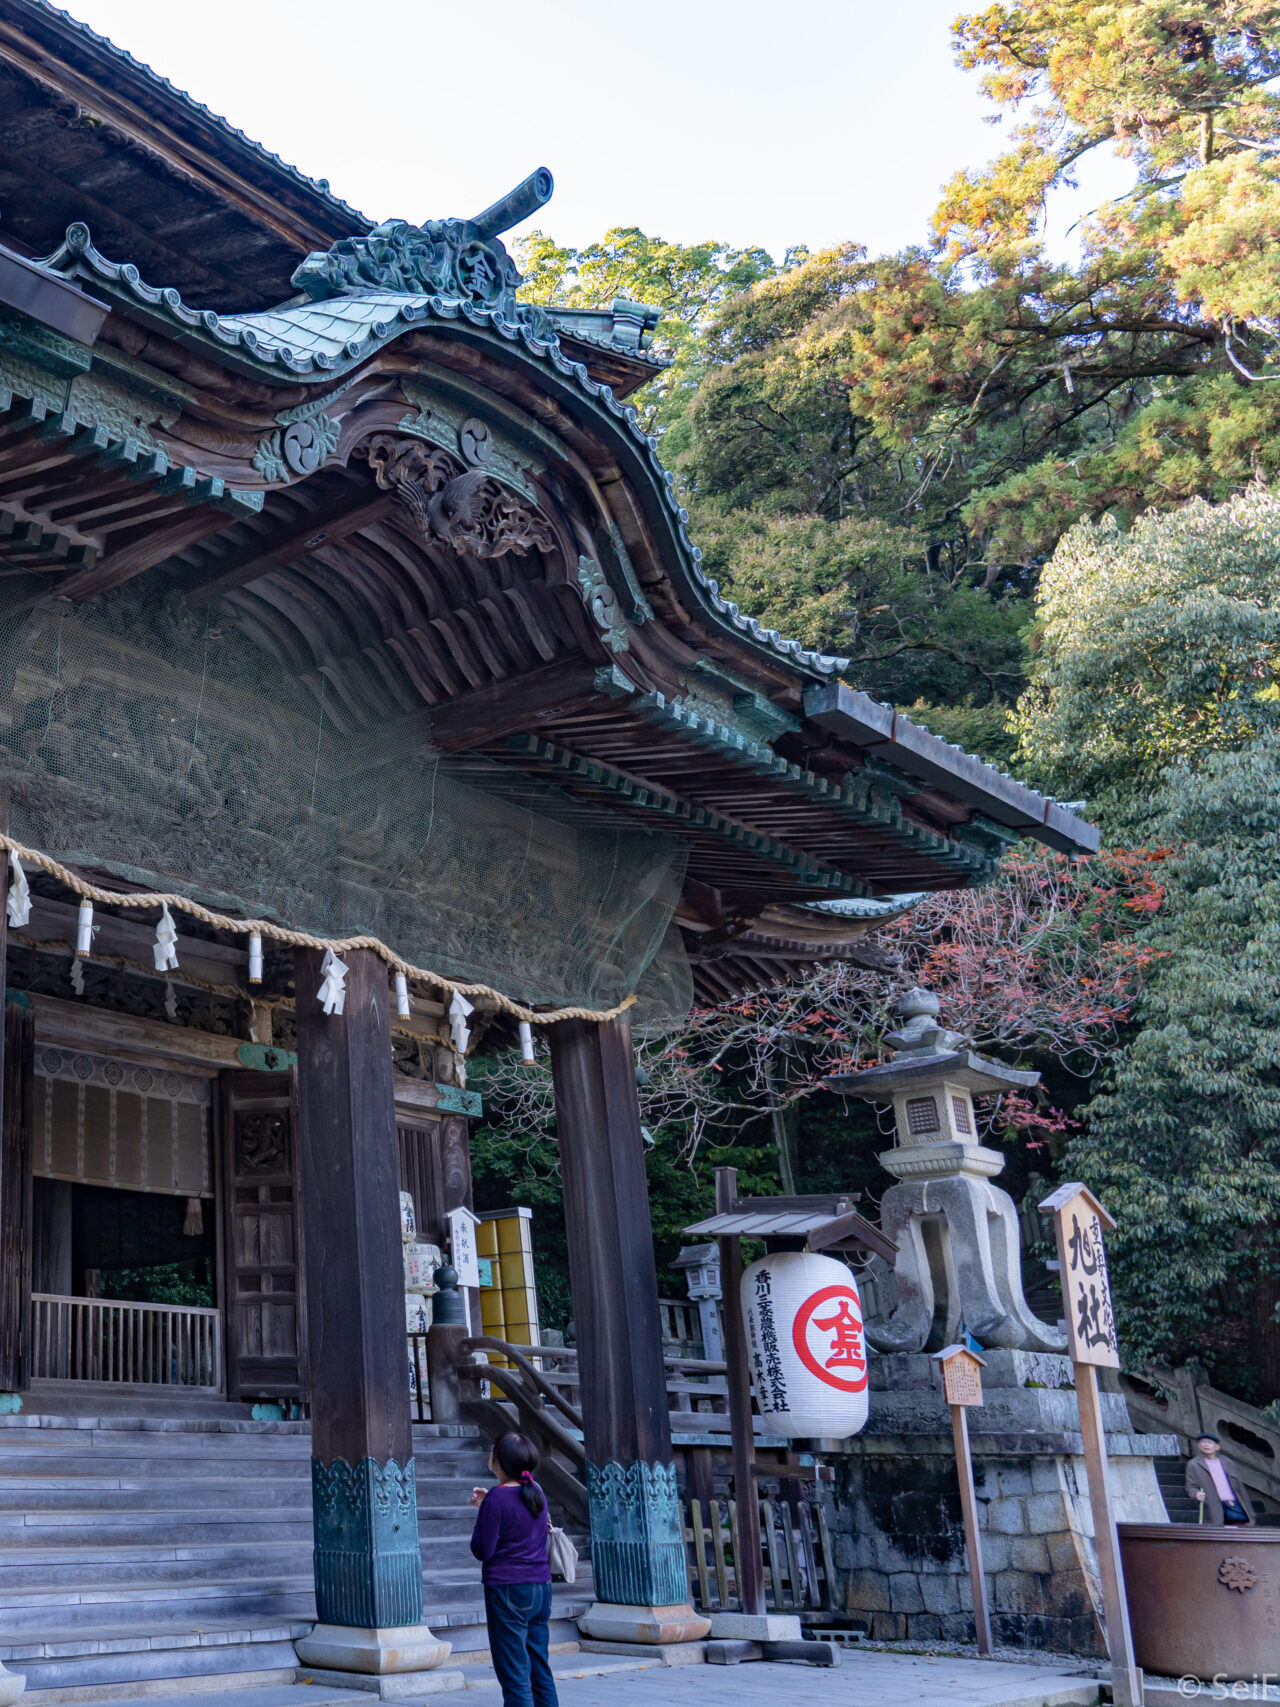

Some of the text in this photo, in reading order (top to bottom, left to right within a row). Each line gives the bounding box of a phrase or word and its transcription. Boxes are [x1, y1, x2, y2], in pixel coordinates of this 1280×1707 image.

[754, 1269, 791, 1413] 香川三菱農機販売株式会社
[811, 1300, 866, 1372] 金
[1068, 1213, 1110, 1349] 旭社
